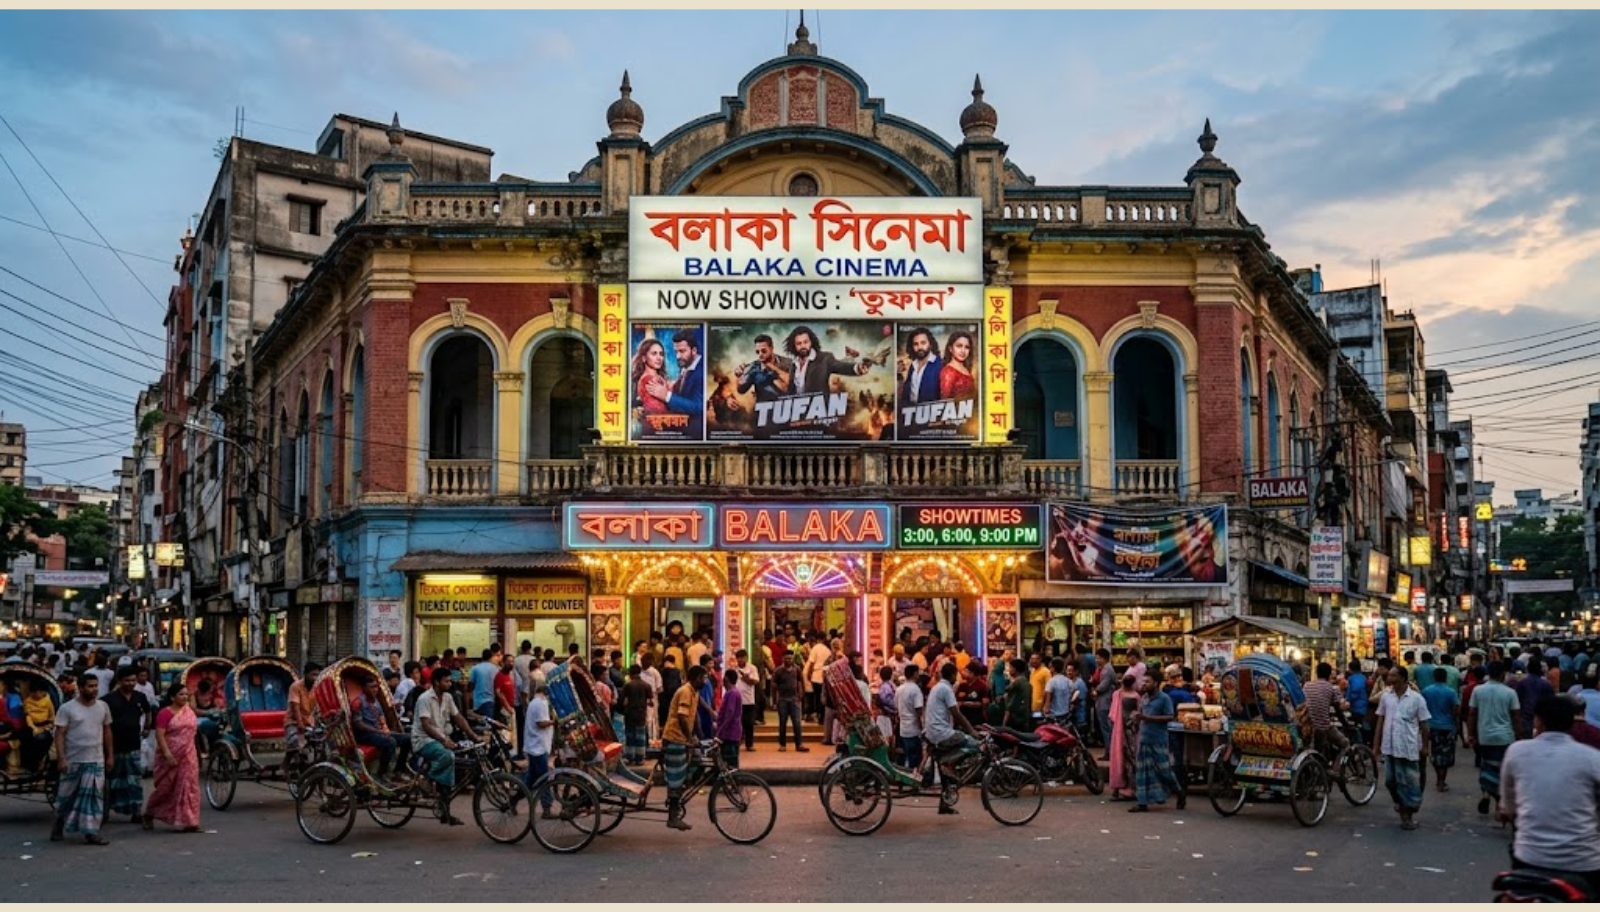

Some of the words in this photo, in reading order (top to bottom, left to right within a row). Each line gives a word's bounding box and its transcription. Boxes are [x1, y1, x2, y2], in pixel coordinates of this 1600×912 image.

[644, 207, 797, 252] বলাকা
[808, 199, 972, 253] সিনেমা
[684, 257, 806, 276] BALAKA
[815, 258, 928, 277] CINEMA
[657, 290, 711, 309] NOW
[718, 290, 827, 310] SHOWING
[755, 392, 848, 427] TUFAN
[901, 399, 974, 427] TUFAN
[1251, 481, 1307, 497] BALAKA
[578, 510, 702, 541] বলাকা
[725, 509, 883, 542] BALAKA
[920, 509, 1022, 524] SHOWTIMES
[904, 528, 938, 545] 3:00,
[942, 528, 976, 545] 6:00,
[980, 528, 1010, 543] 9:00
[1014, 528, 1037, 543] PM
[452, 600, 495, 611] COUNTER
[541, 600, 584, 610] COUNTER
